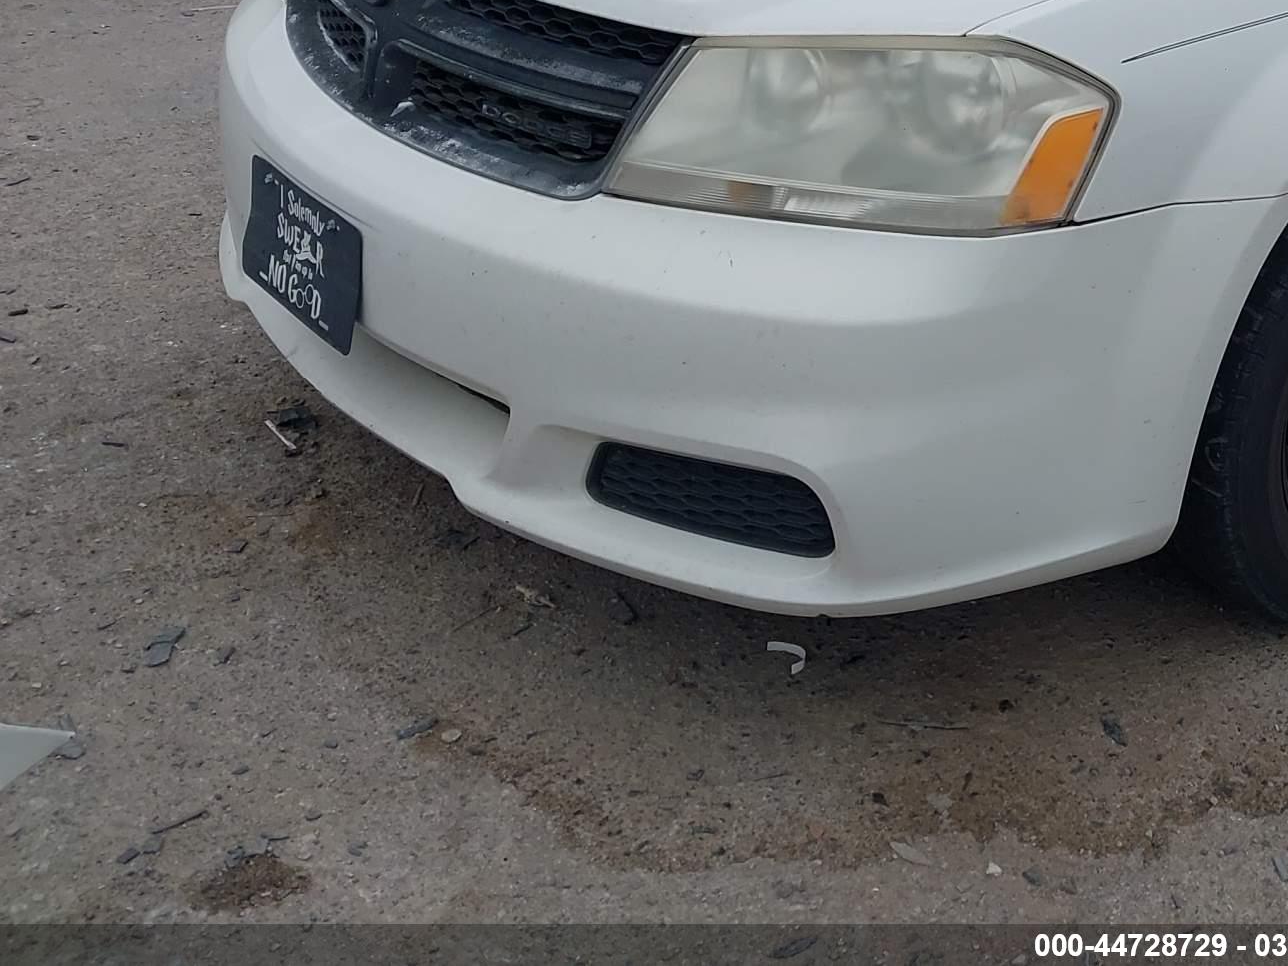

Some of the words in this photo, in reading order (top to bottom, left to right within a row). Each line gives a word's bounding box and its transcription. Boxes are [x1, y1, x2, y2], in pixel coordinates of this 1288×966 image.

[481, 103, 592, 149] DODGE
[279, 184, 284, 209] I
[287, 189, 326, 237] Solemnly
[268, 253, 287, 294] NO
[288, 273, 322, 319] GOOD
